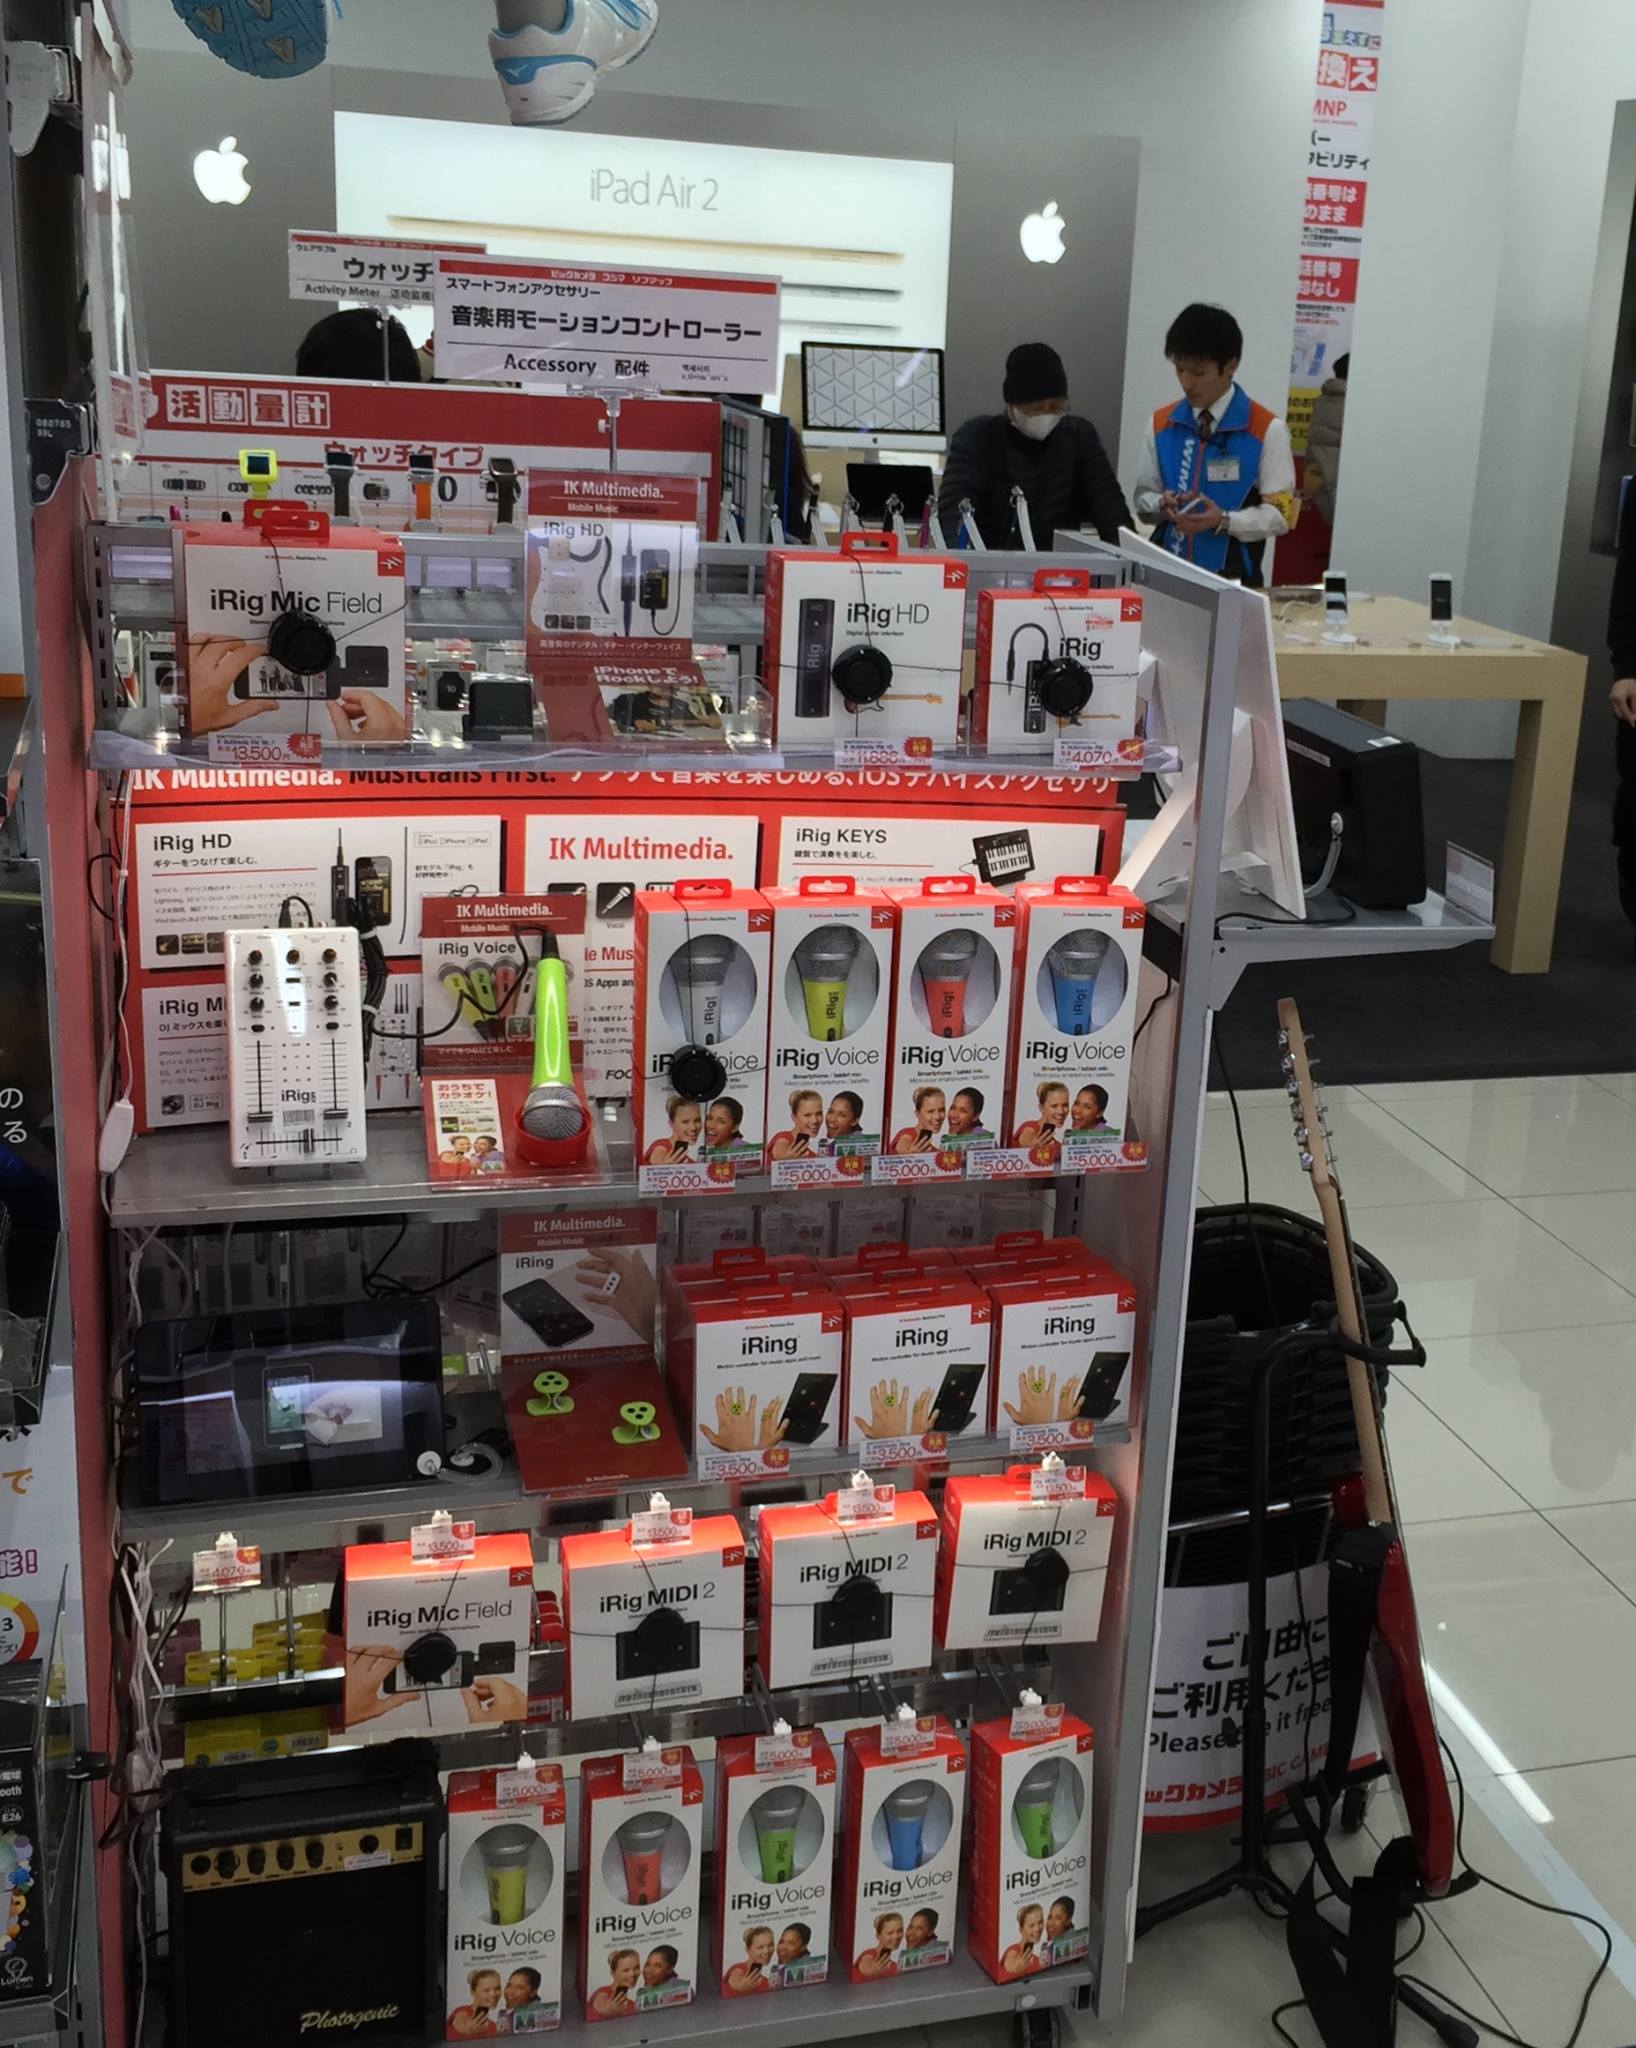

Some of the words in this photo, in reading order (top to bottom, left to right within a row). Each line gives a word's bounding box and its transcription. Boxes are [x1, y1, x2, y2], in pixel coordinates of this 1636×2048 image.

[590, 167, 650, 206] iPad
[656, 173, 697, 209] Air
[701, 177, 719, 212] 2
[304, 283, 347, 298] Activity
[446, 277, 601, 298] スマートフォンアクセサリー
[451, 304, 762, 342] 音楽用モーションコントローラー
[502, 353, 597, 380] Accessory
[614, 358, 651, 378] 配件
[168, 386, 330, 428] 活動量計
[563, 480, 578, 495] IK
[582, 481, 664, 500] Multimedia.
[567, 502, 594, 513] Mobile
[595, 503, 619, 514] Music
[543, 522, 575, 539] iRig
[580, 523, 604, 538] HD
[209, 589, 265, 615] iRig
[270, 590, 321, 613] Mic
[327, 592, 383, 614] Field
[846, 602, 892, 628] iRig
[896, 603, 930, 624] HD
[1059, 637, 1102, 660] iRig
[133, 769, 165, 790] IK
[171, 769, 342, 788] Multimedia.
[348, 770, 482, 785] Musicians
[153, 835, 194, 854] iRig
[201, 833, 232, 849] HD
[549, 837, 578, 860] IK
[582, 836, 734, 860] Multimedia.
[796, 828, 831, 846] iRig
[836, 828, 887, 844] KEYS
[456, 904, 472, 918] IK
[474, 903, 553, 918] Multimedia.
[438, 941, 470, 957] iRig
[474, 942, 517, 956] Voice
[601, 946, 634, 961] Mus
[595, 977, 619, 990] Apps
[158, 998, 200, 1017] iRig
[776, 1049, 821, 1071] iRig
[823, 1045, 879, 1066] Voice
[901, 1045, 944, 1067] iRig
[948, 1043, 1000, 1064] Voice
[1026, 1041, 1069, 1063] iRig
[1073, 1041, 1126, 1061] Voice
[281, 1089, 311, 1104] iRig
[533, 1220, 548, 1233] IK
[551, 1215, 627, 1232] Multimedia.
[515, 1256, 554, 1270] iRing
[1044, 1316, 1095, 1335] iRing
[742, 1335, 798, 1355] iRing
[896, 1328, 949, 1347] iRing
[984, 1533, 1022, 1551] iRig
[1026, 1530, 1072, 1549] MIDI
[1075, 1529, 1087, 1545] 2
[800, 1562, 840, 1583] iRig
[844, 1555, 892, 1577] MIDI
[896, 1553, 909, 1571] 2
[599, 1592, 643, 1614] iRig
[647, 1584, 698, 1606] MIDI
[703, 1581, 716, 1599] 2
[367, 1608, 412, 1629] iRig
[417, 1605, 460, 1624] Mic
[465, 1599, 513, 1619] Field
[1276, 1709, 1290, 1733] it
[1004, 1868, 1041, 1890] iRig
[1043, 1853, 1087, 1878] Voice
[863, 1880, 902, 1898] iRig
[905, 1868, 954, 1891] Voice
[731, 1891, 771, 1911] iRig
[774, 1882, 826, 1904] Voice
[594, 1915, 637, 1934] iRig
[640, 1905, 693, 1926] Voice
[453, 1934, 497, 1953] iRig
[501, 1928, 556, 1947] Voice
[299, 2003, 401, 2034] Photogenic
